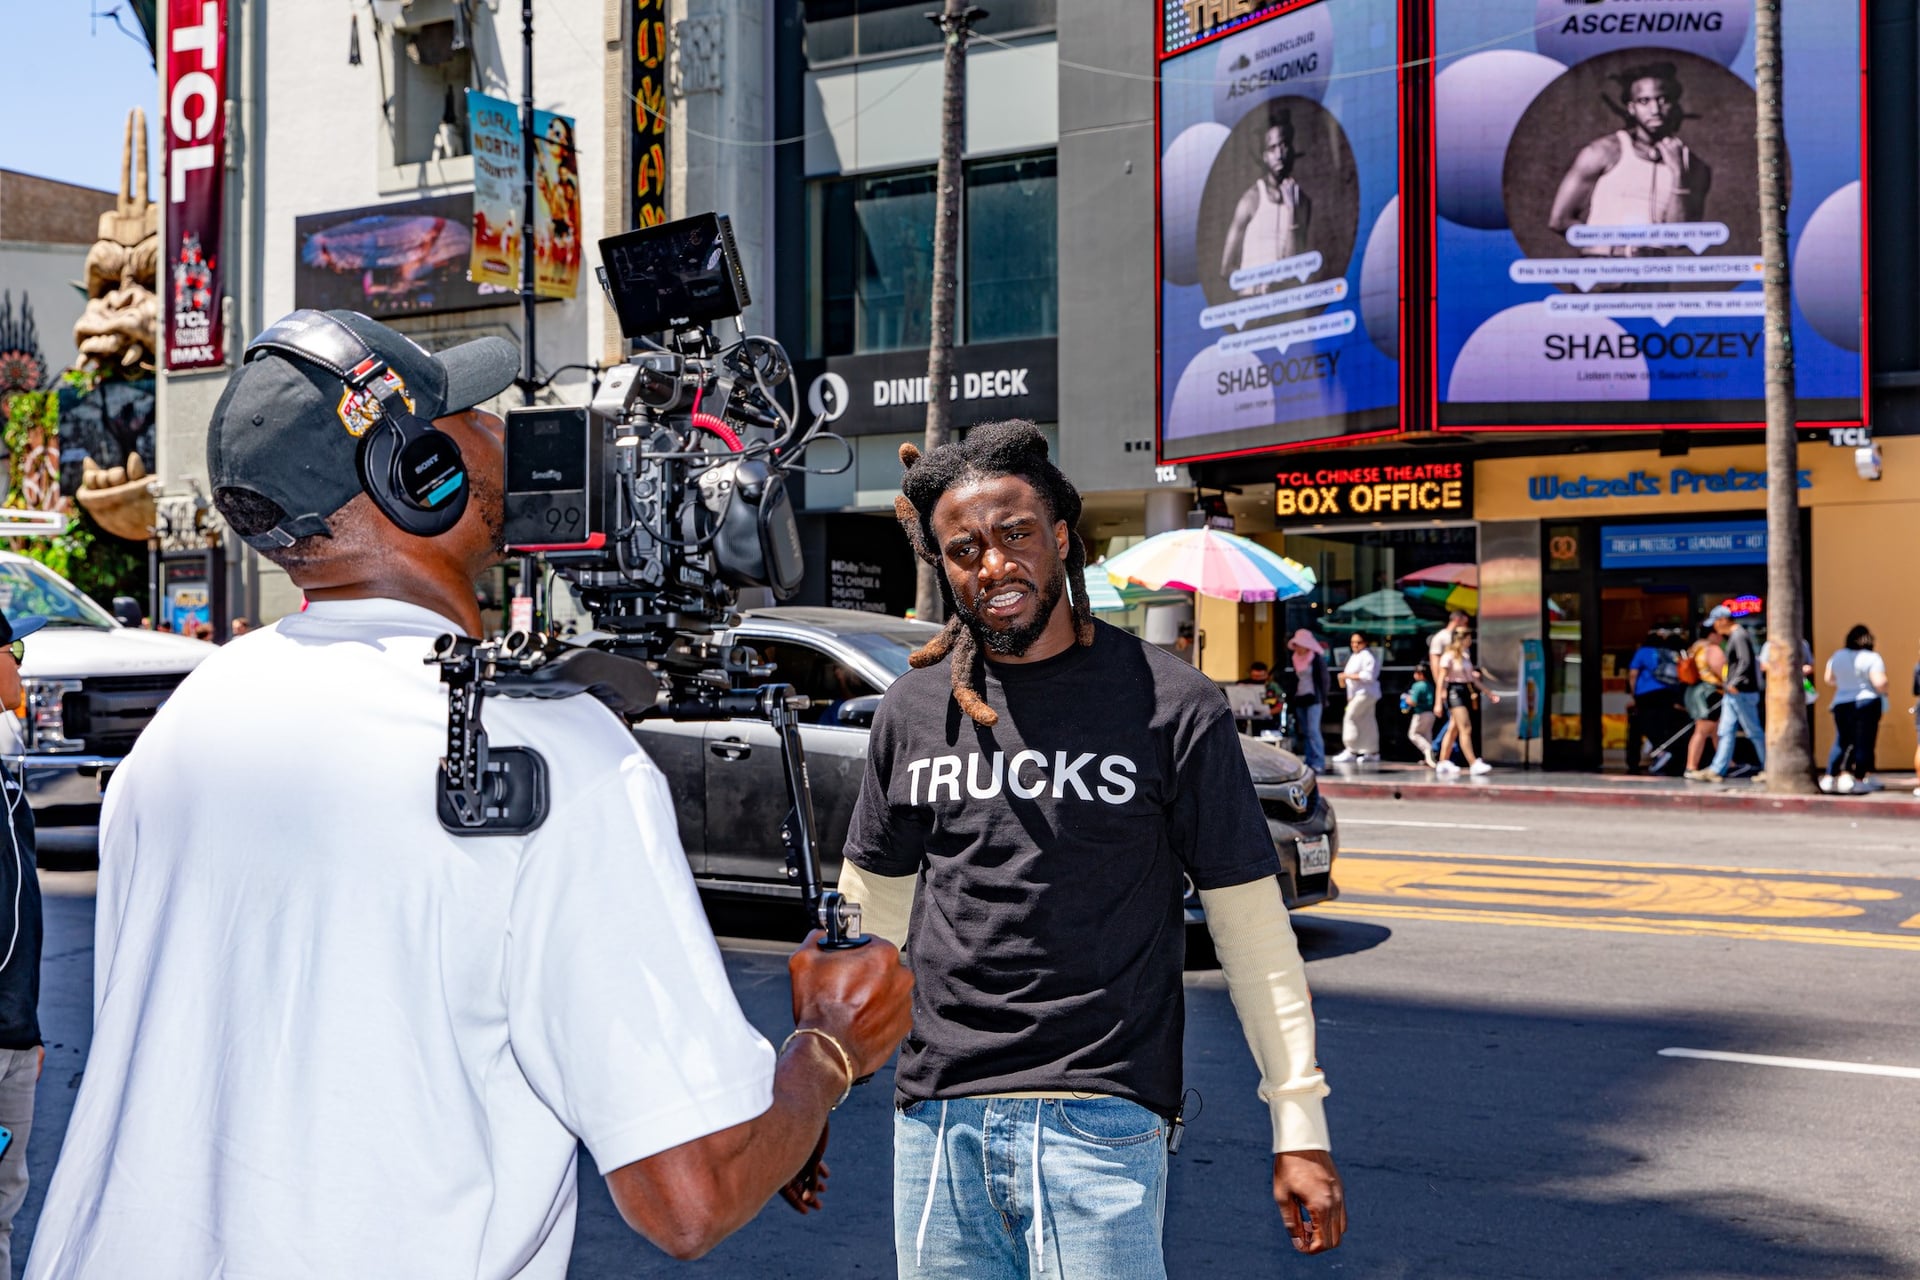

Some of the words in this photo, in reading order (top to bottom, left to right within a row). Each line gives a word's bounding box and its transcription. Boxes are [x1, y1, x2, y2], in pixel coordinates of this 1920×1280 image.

[1561, 12, 1723, 34] ASCENDING
[1255, 31, 1315, 62] SOUNDCLOUD
[1228, 53, 1318, 101] ASCENDING
[171, 1, 218, 203] TCL
[474, 133, 521, 160] NORTH
[175, 311, 210, 329] TCL
[171, 345, 215, 364] IMAX
[1544, 332, 1760, 361] SHABOOZEY
[1217, 350, 1340, 396] SHABOOZEY
[1577, 370, 1611, 381] Listen
[1614, 372, 1637, 381] now
[874, 375, 958, 406] DINI
[964, 368, 1029, 399] DECK
[1829, 428, 1870, 446] TCL
[415, 454, 438, 474] SONY
[1155, 466, 1177, 482] TCL
[1277, 473, 1314, 486] TCL
[1316, 467, 1380, 485] CHINESE
[1384, 463, 1462, 482] THEATRES
[1529, 470, 1661, 500] Wetzel's
[1670, 467, 1812, 494] Pretzes
[1277, 486, 1340, 515] BOX
[1350, 481, 1462, 512] OFFICE
[546, 507, 580, 533] 99
[907, 750, 1137, 806] TRUCKS
